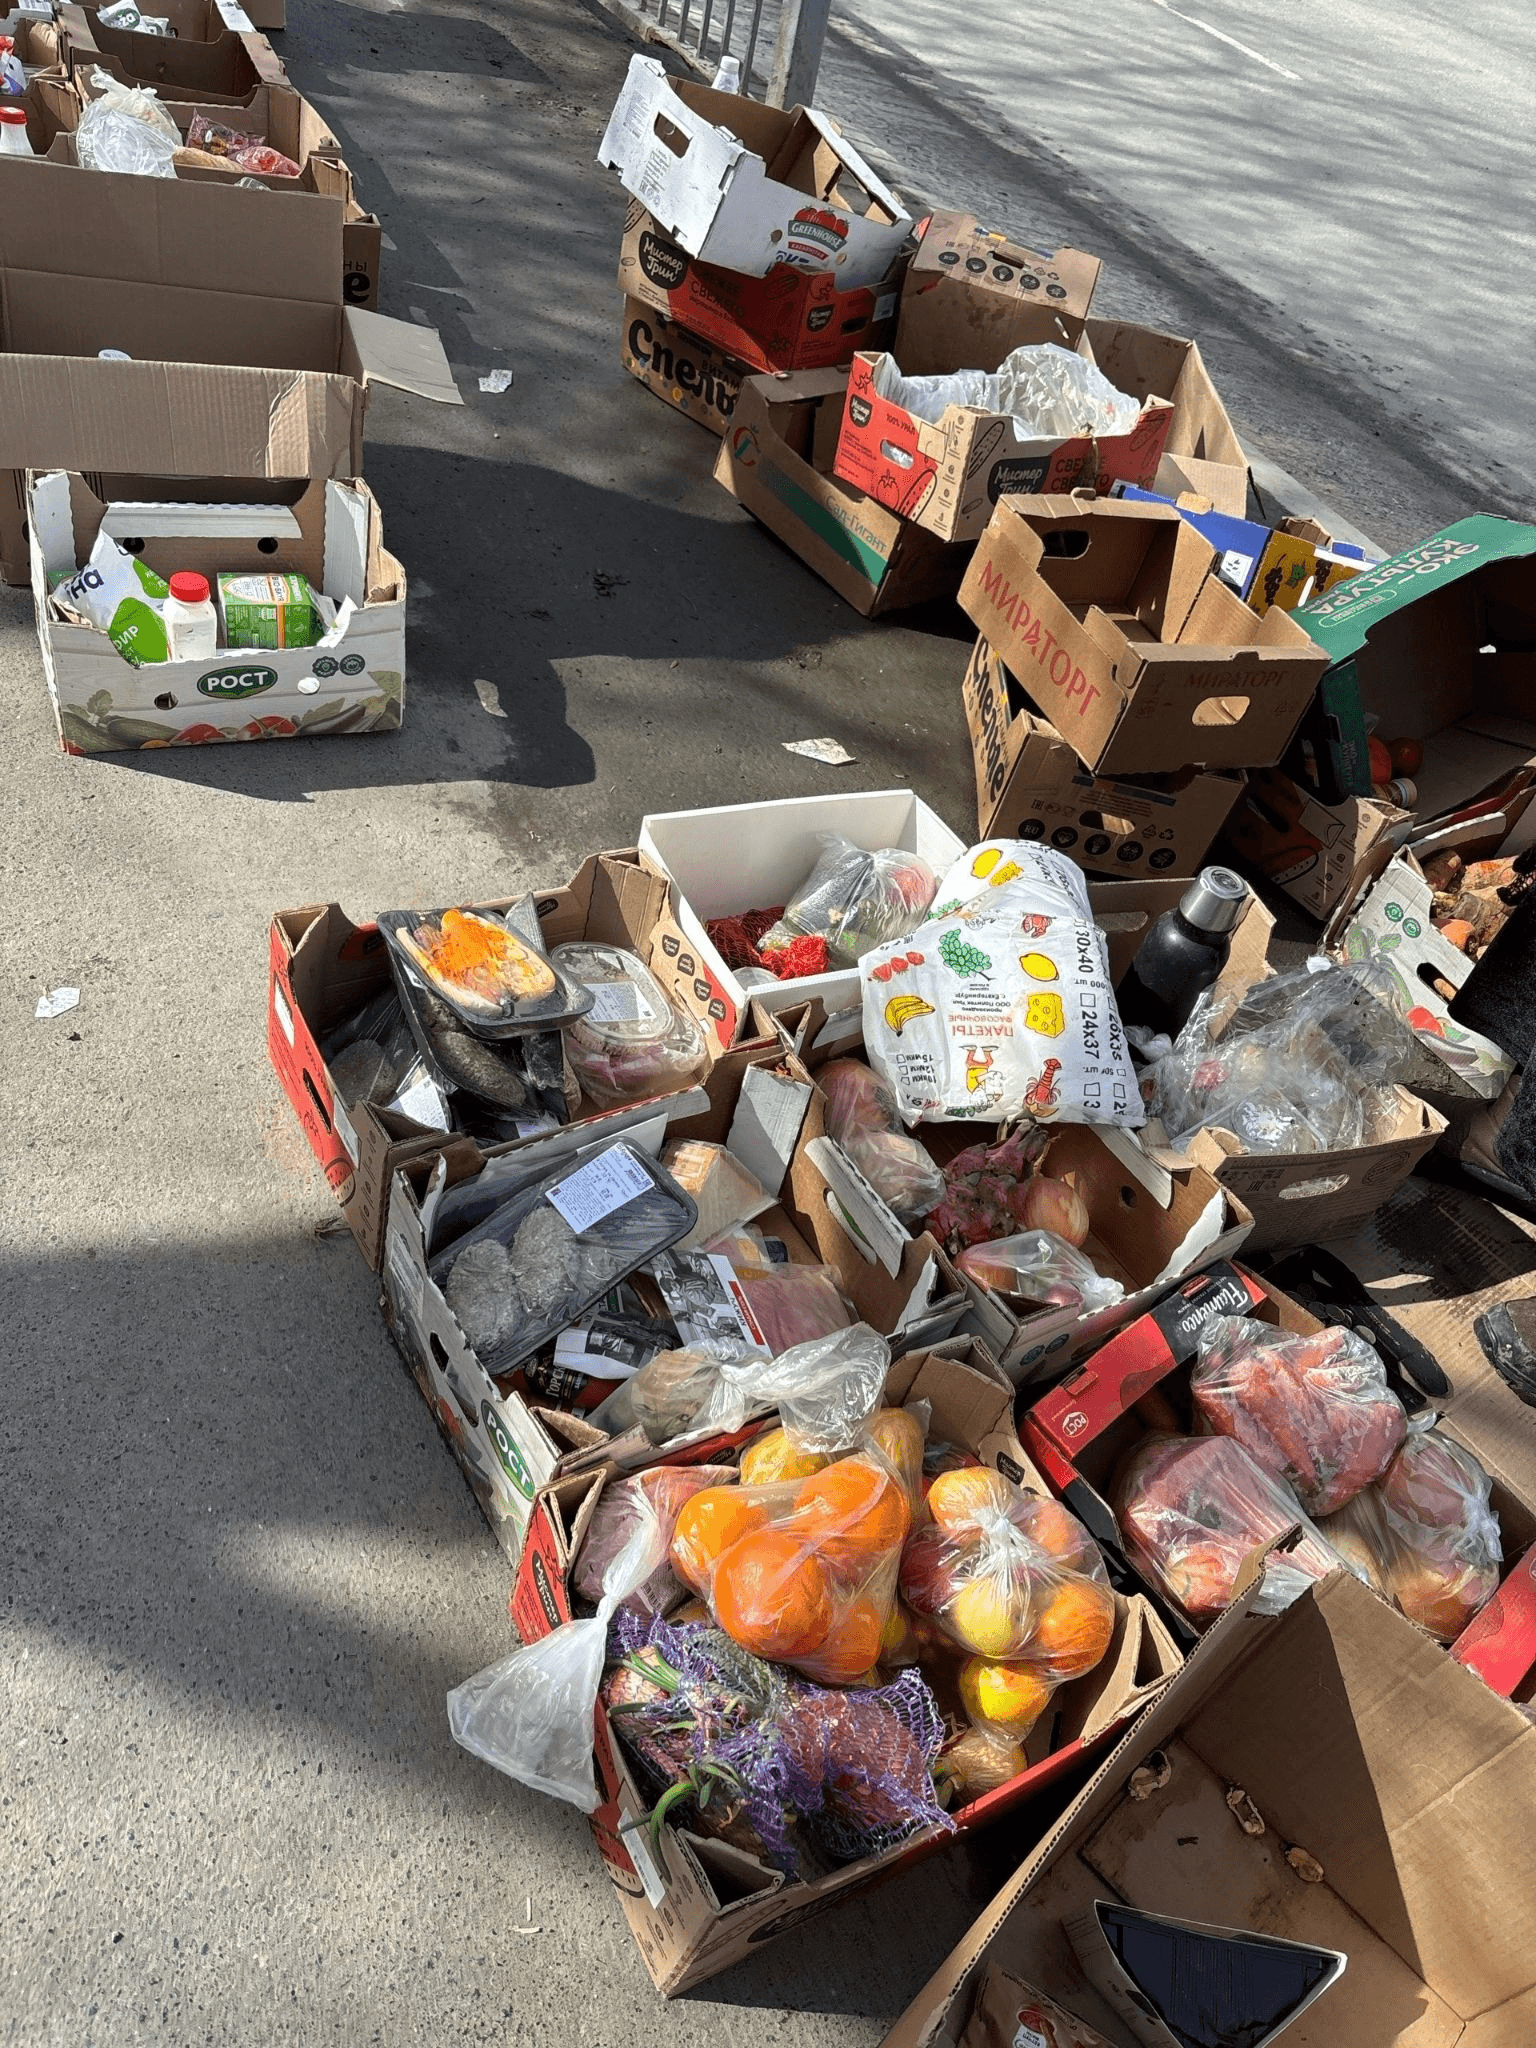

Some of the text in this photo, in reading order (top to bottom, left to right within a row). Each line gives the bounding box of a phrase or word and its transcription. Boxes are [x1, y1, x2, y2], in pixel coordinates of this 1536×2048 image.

[791, 222, 843, 248] GREENHOUSE
[643, 237, 683, 274] Мистер
[646, 256, 677, 282] Грин
[997, 465, 1042, 487] Мистер
[826, 495, 888, 553] Сад-Гигант
[1309, 539, 1461, 615] КУЛЬТУРА
[978, 560, 1101, 717] МИРАТОРГ
[207, 671, 269, 691] РОСТ
[1185, 669, 1289, 689] МИРАТОРГ
[973, 635, 1005, 803] Спелые
[1023, 824, 1040, 835] RU
[952, 1025, 1014, 1037] ПАКЕТЫ
[1081, 1010, 1100, 1060] 24x37
[1108, 1013, 1123, 1062] 26x35
[1182, 1282, 1249, 1333] Flamenco
[1065, 1412, 1088, 1436] РОСТ
[487, 1413, 531, 1487] РОСТ
